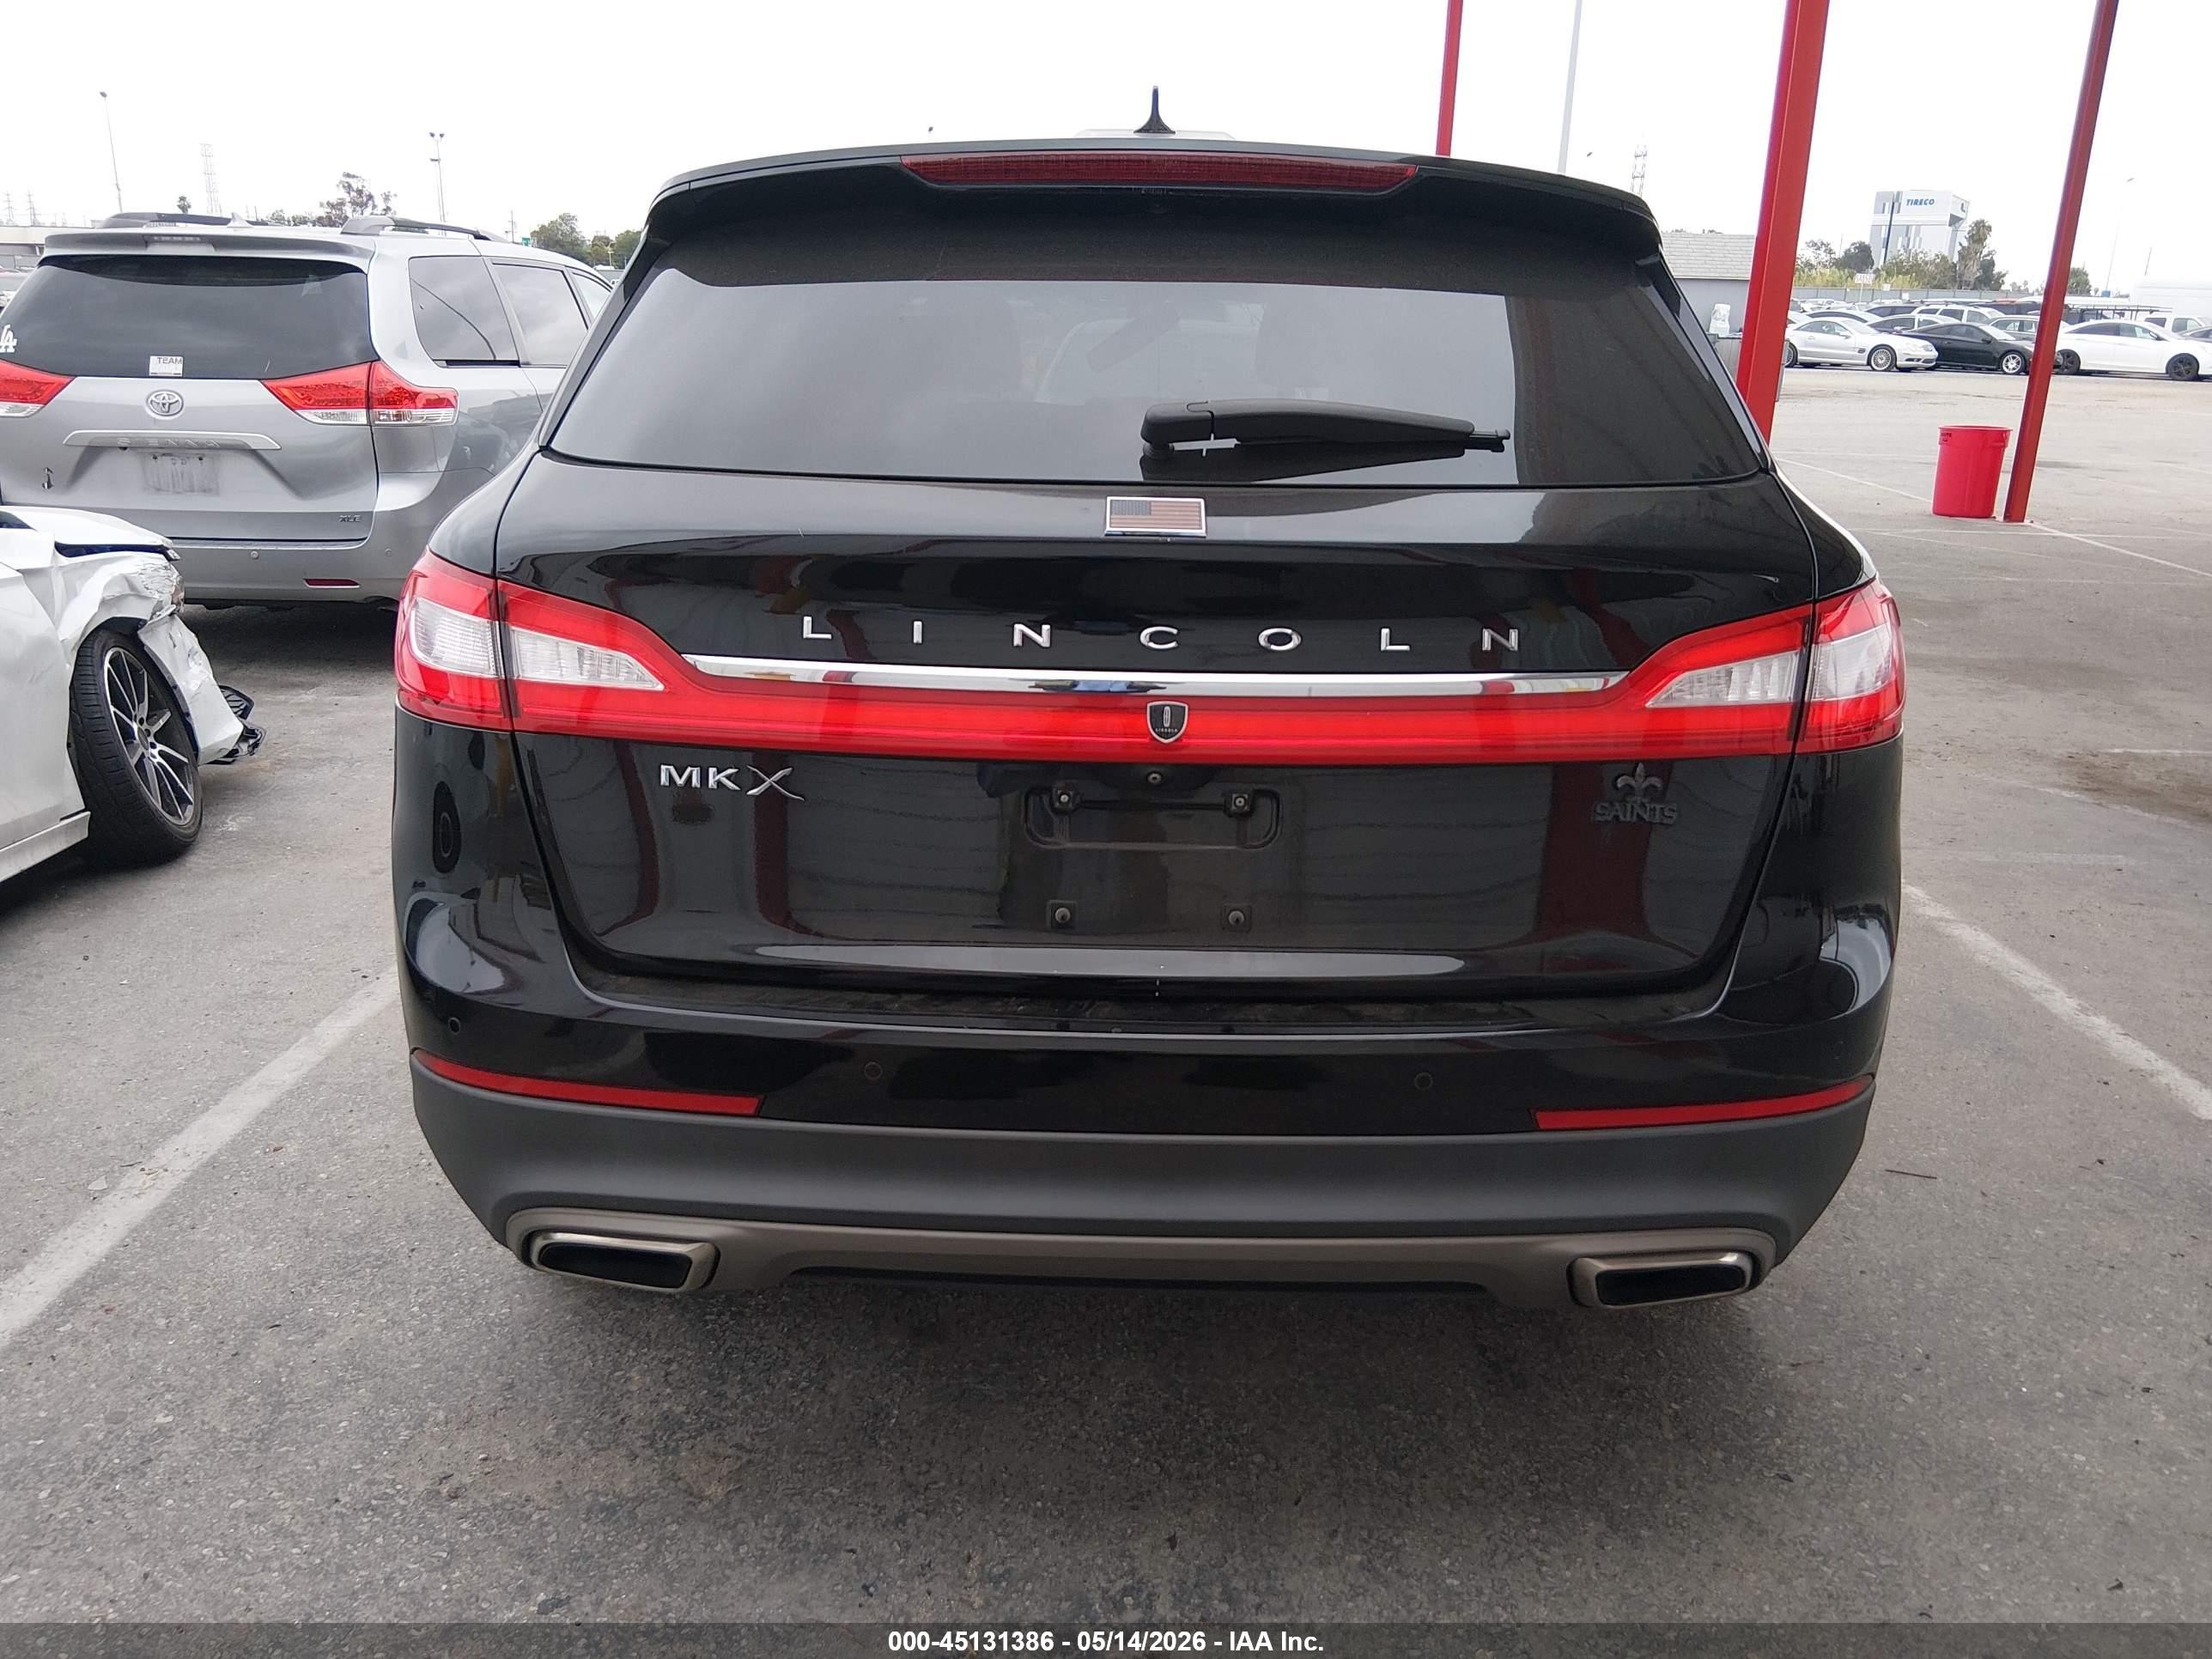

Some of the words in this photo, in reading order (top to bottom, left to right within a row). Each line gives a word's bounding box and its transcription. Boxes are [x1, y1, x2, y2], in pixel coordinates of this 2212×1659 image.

[337, 514, 362, 523] XLE
[801, 616, 1519, 652] LINCOLN
[659, 764, 804, 800] MKX
[1593, 803, 1678, 824] SAINTS
